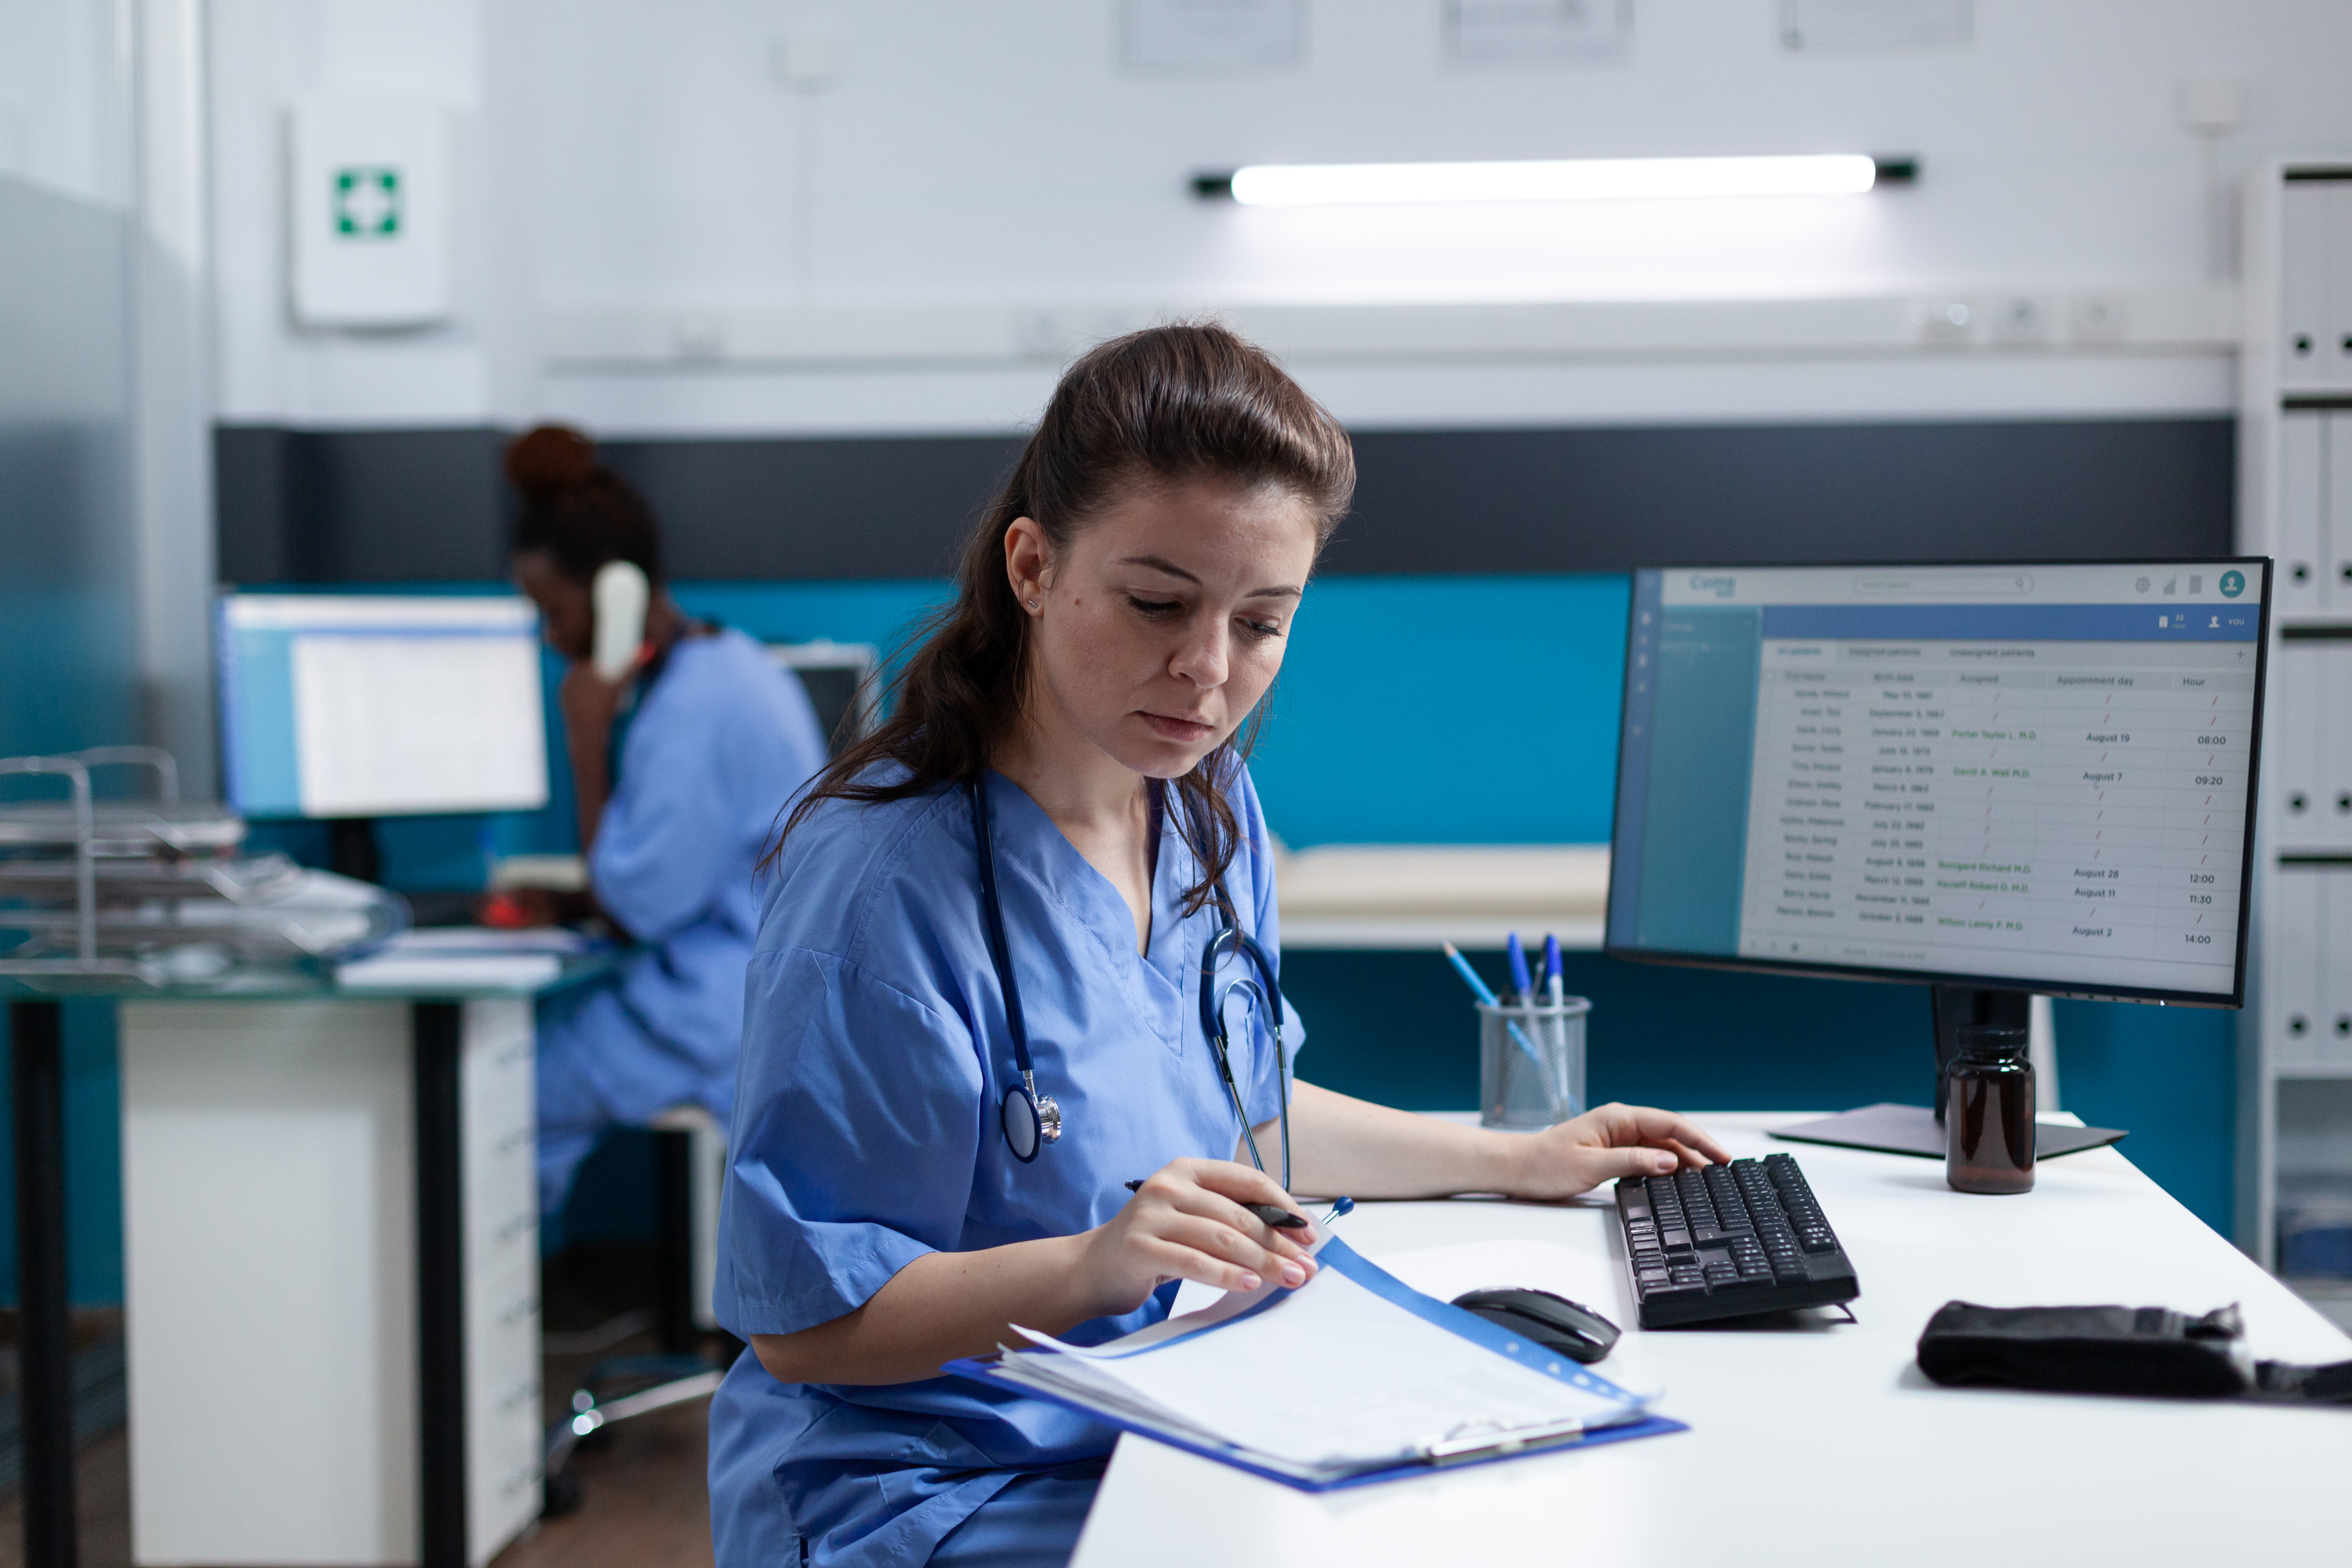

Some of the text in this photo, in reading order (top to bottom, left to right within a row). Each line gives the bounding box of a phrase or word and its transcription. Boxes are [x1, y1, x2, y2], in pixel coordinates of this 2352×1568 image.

[1950, 649, 1998, 658] Unassigned
[1960, 675, 1999, 684] Assigned
[2057, 676, 2134, 687] Appointment day
[2183, 678, 2205, 686] Hour
[2087, 733, 2130, 743] August 19
[2198, 736, 2226, 745] 08:00
[2083, 772, 2123, 782] August 7
[2195, 776, 2223, 785] 09:20
[2074, 868, 2119, 879] August 28
[2190, 874, 2214, 884] 12:00
[2074, 887, 2106, 898] August
[2190, 895, 2212, 904] 11:30
[2073, 926, 2112, 937] August 2
[2185, 934, 2211, 944] 14:00
